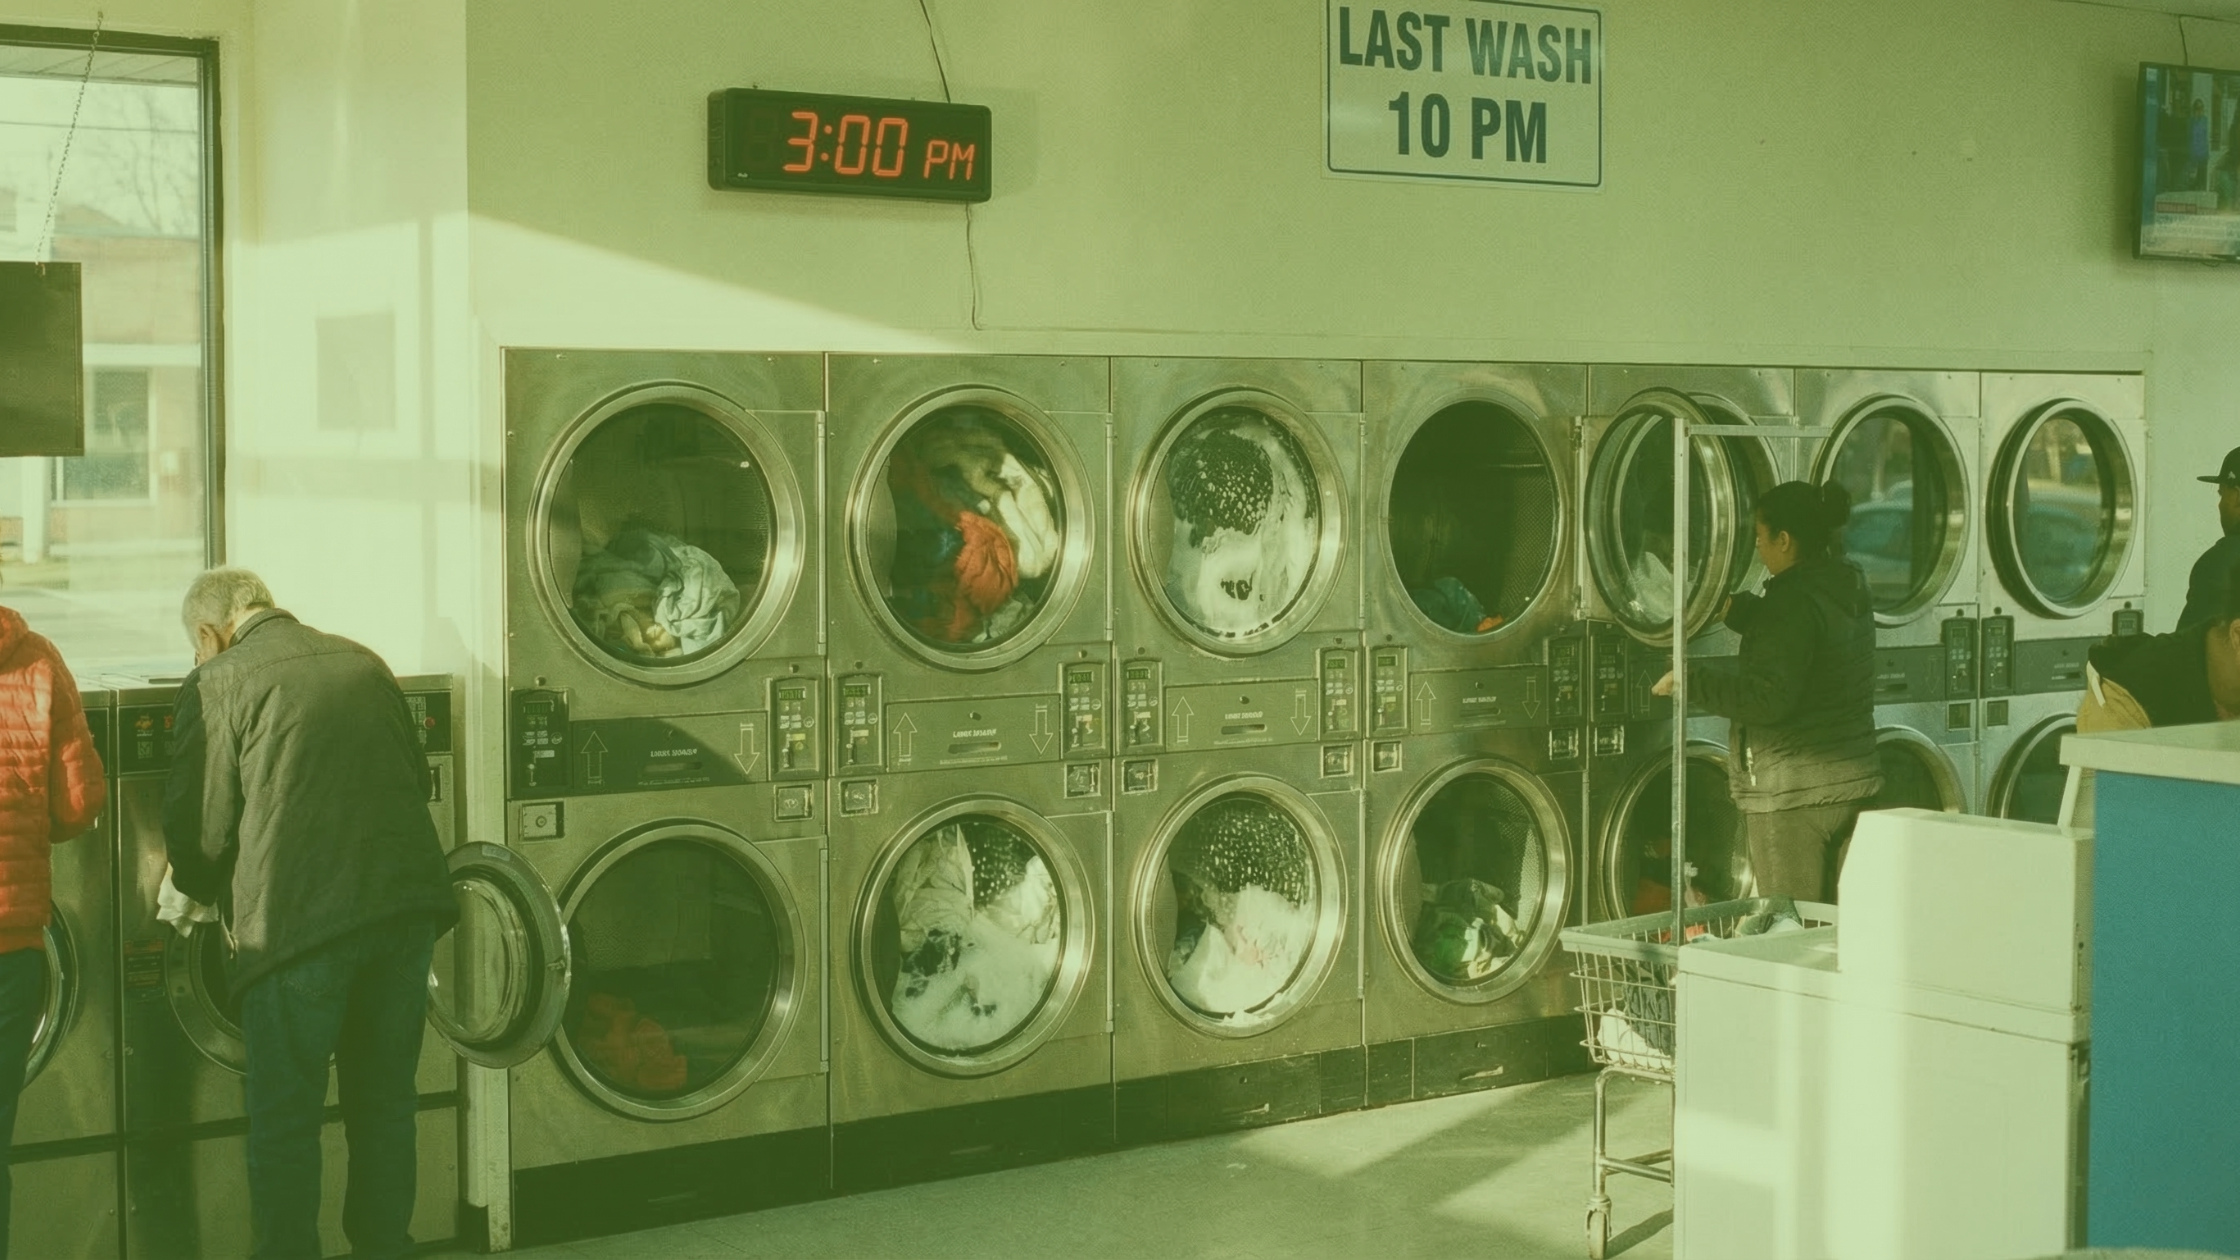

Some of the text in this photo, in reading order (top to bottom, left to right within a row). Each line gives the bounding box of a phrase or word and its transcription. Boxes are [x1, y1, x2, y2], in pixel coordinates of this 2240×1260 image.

[1339, 6, 1592, 84] LAST WASH
[782, 111, 975, 180] 3:00 PM
[1388, 91, 1547, 164] 10 PM
